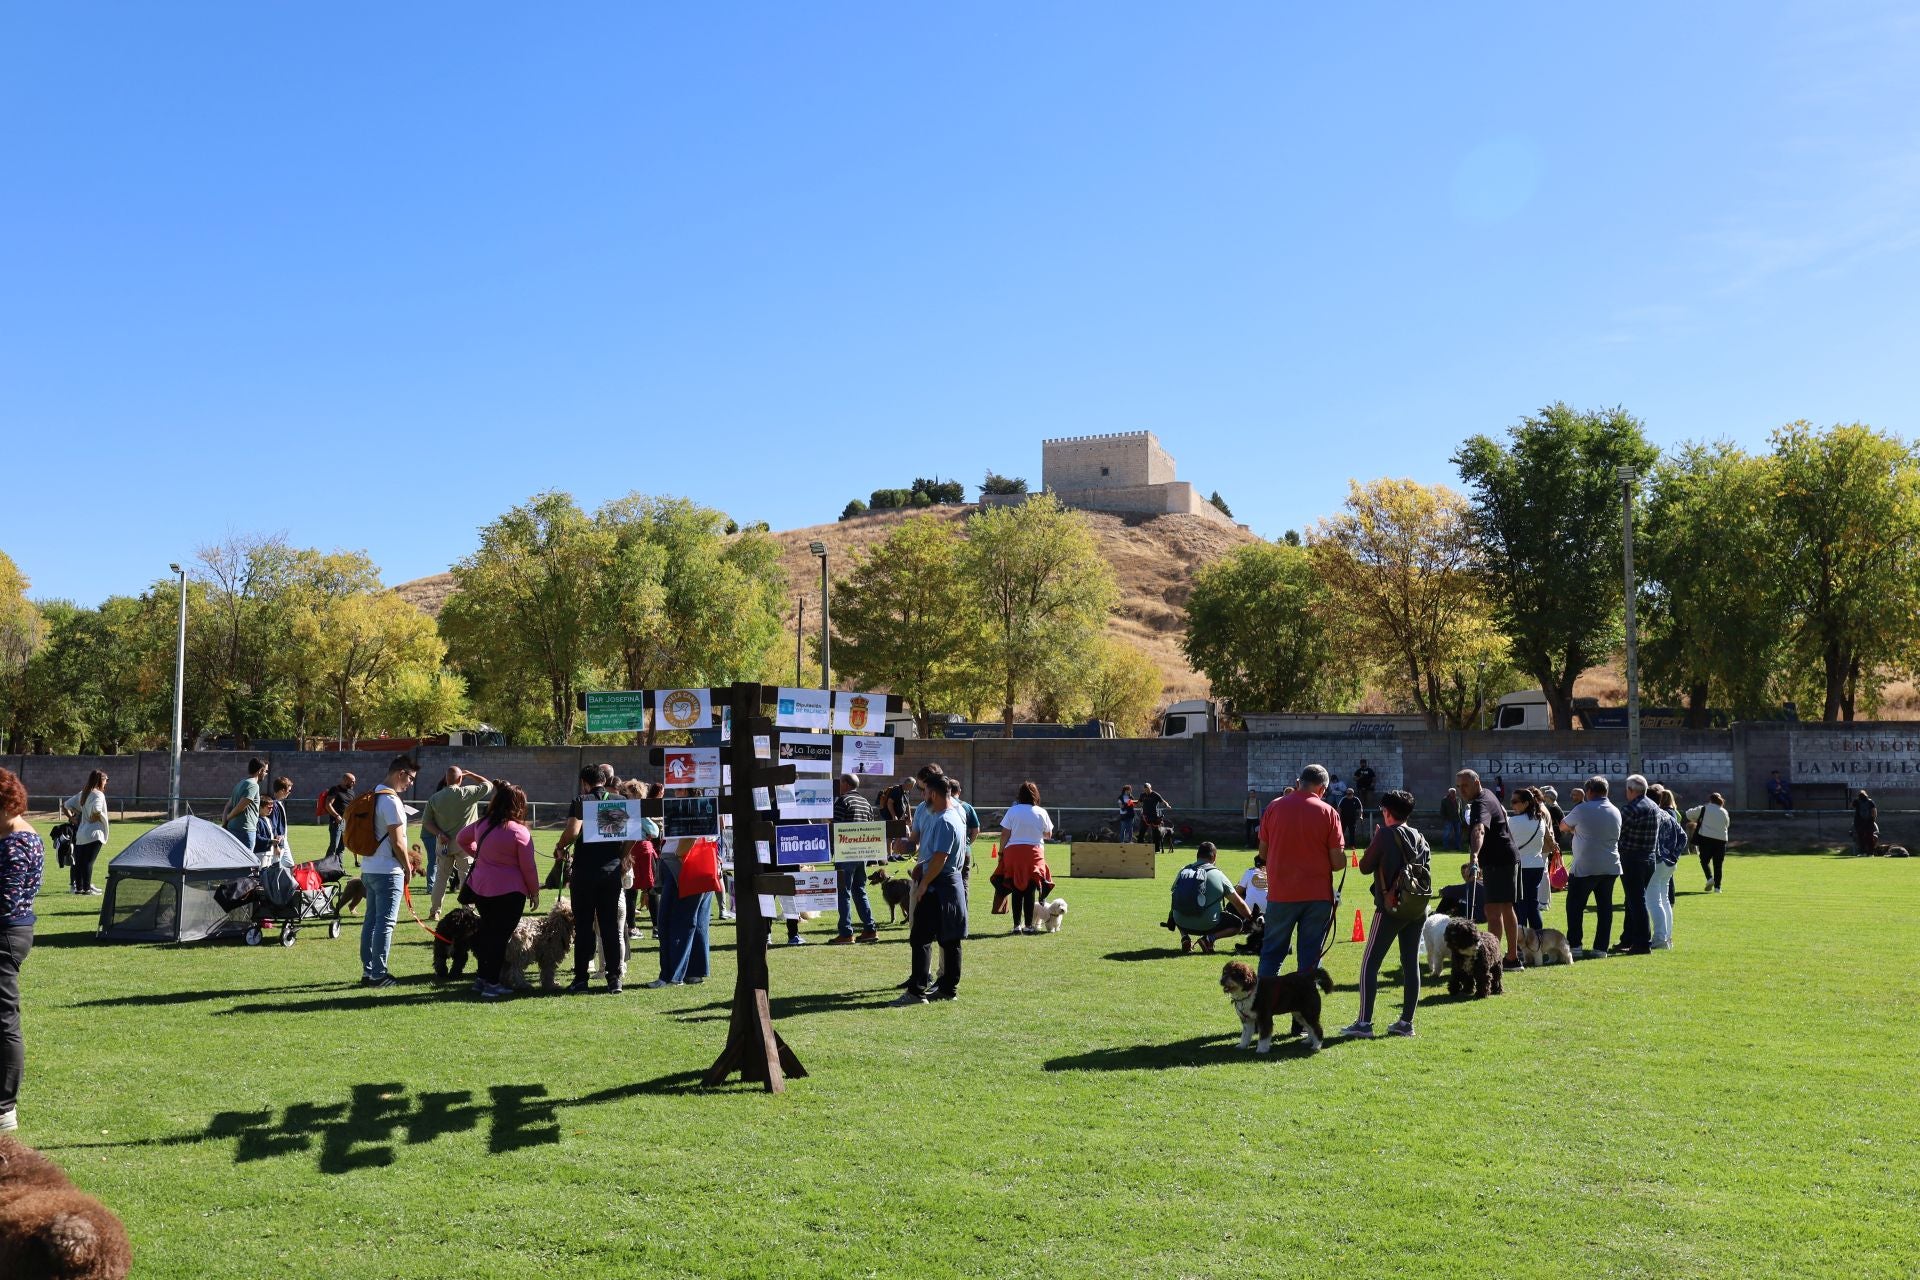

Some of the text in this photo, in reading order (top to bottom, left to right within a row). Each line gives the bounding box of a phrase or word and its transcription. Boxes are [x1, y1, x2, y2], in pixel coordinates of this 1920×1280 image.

[588, 695, 640, 703] BAR JOSEFINA
[794, 744, 804, 754] La
[1830, 739, 1920, 752] CERVECE
[1488, 758, 1560, 774] Diario
[1797, 761, 1821, 774] LA
[780, 837, 827, 852] morado
[838, 833, 882, 844] Montisón
